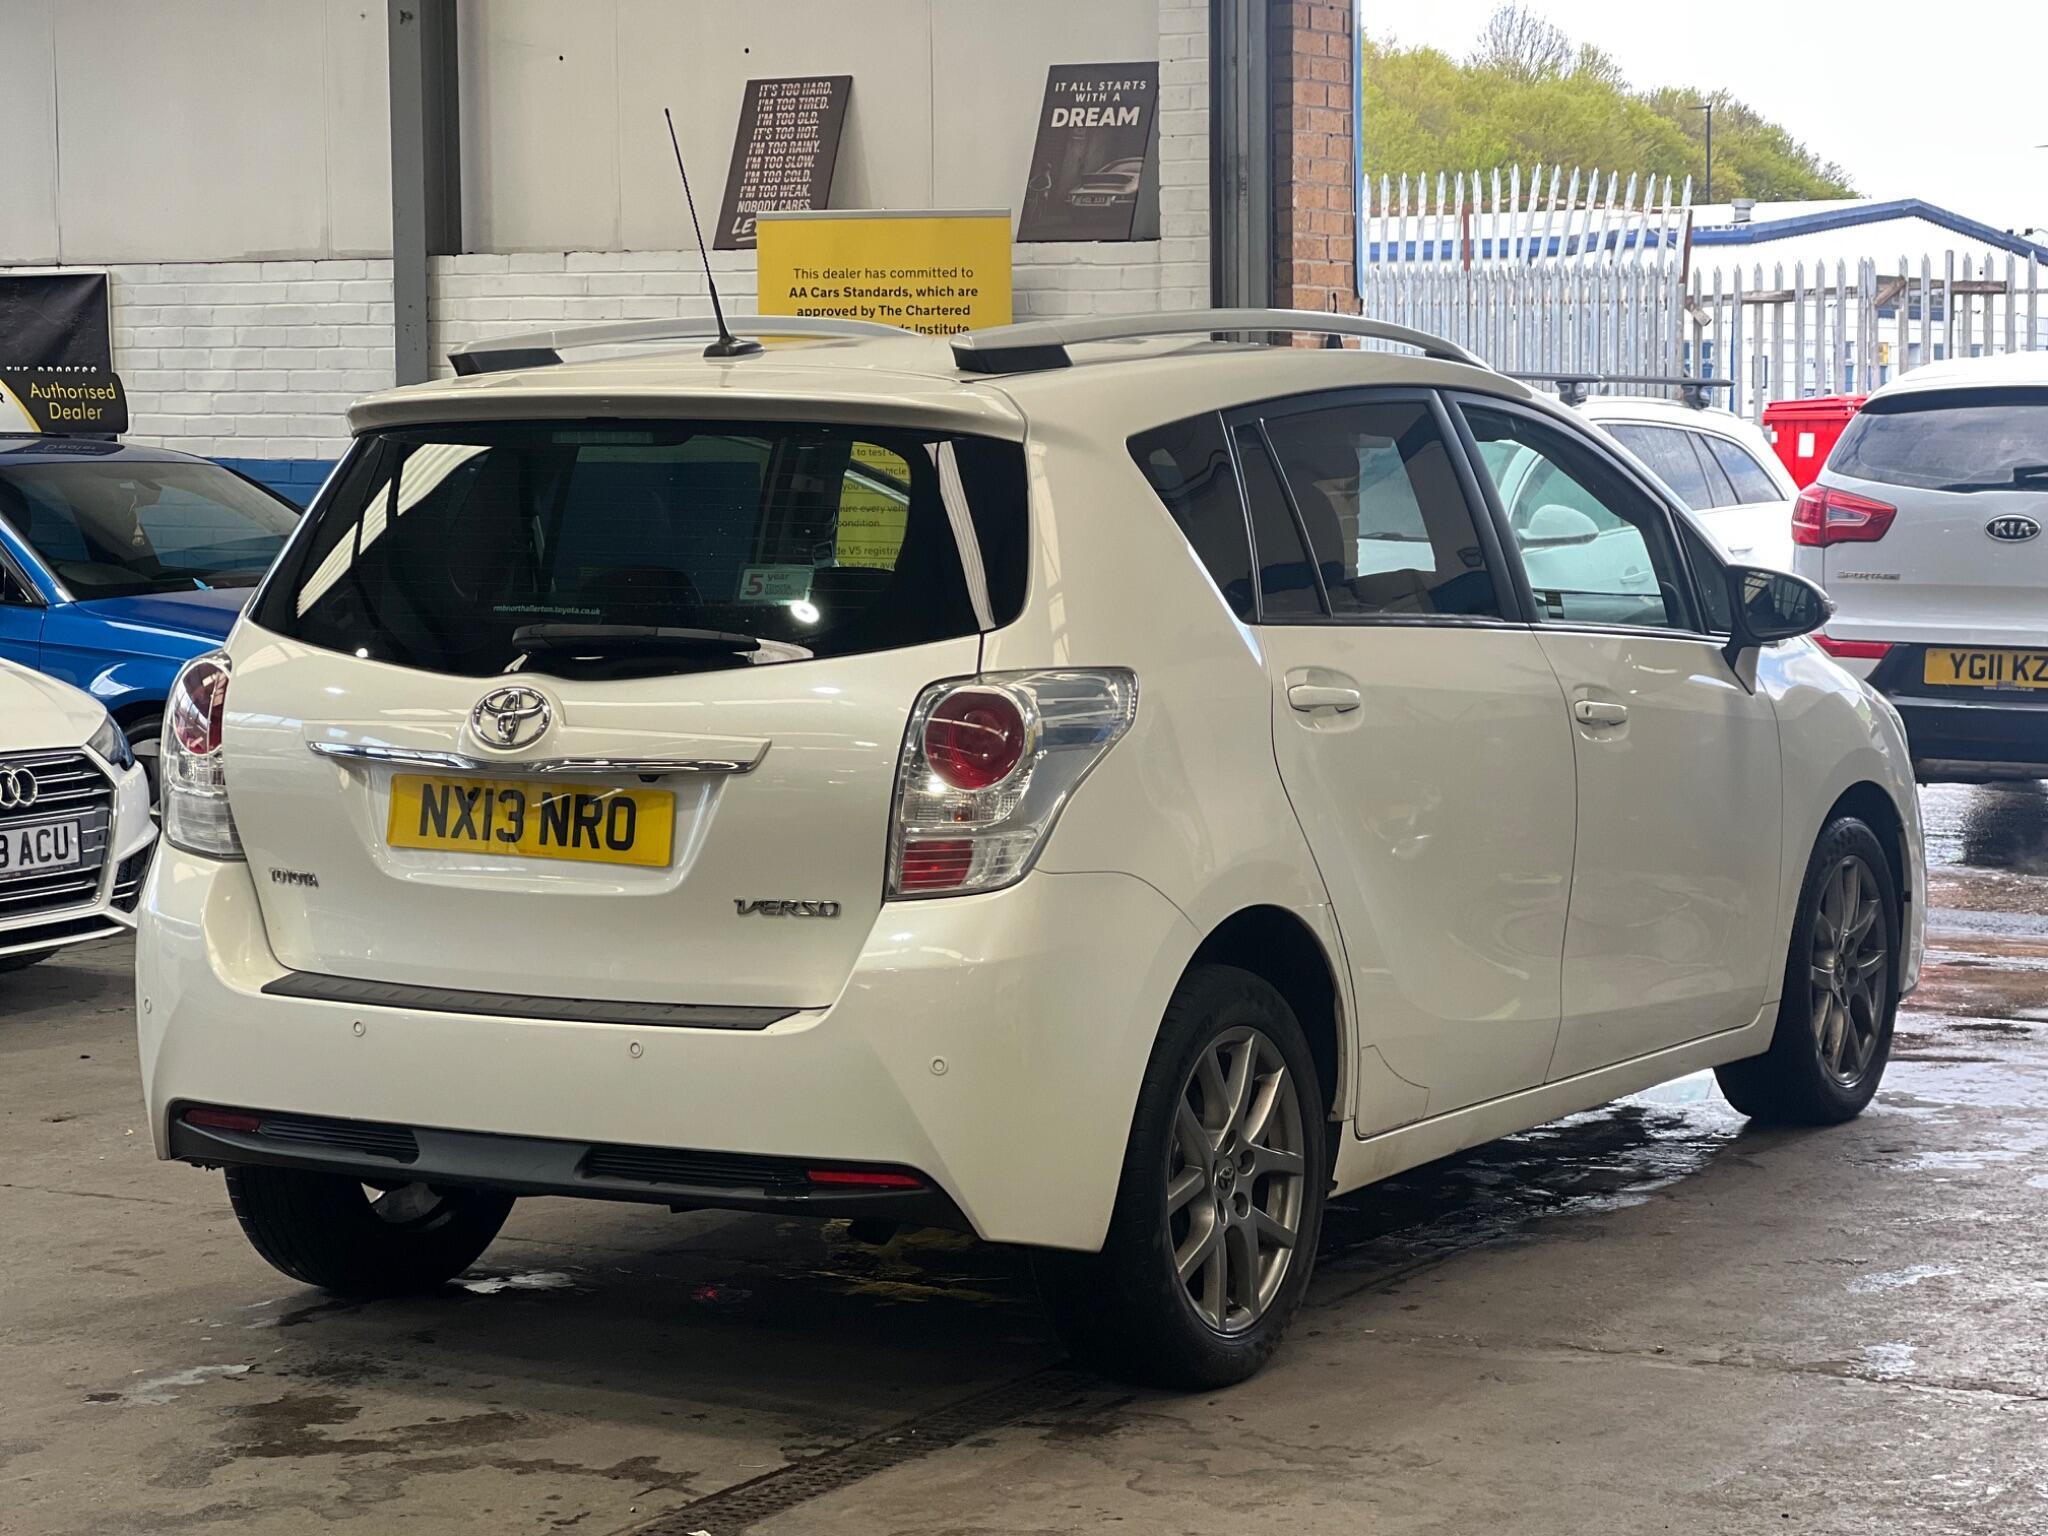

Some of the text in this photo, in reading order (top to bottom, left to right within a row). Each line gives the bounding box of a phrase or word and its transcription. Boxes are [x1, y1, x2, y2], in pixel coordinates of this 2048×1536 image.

[758, 81, 832, 97] IT'S TOO HARD.
[1055, 80, 1147, 92] IT ALL STARTS
[757, 96, 829, 112] I'M TOO TIRED.
[1075, 92, 1121, 102] WITH A
[756, 111, 819, 126] I'M TOO OLD.
[1050, 105, 1140, 128] DREAM
[753, 125, 818, 140] IT'S TOO HOT.
[748, 139, 820, 155] I'M TOO RAINY.
[745, 154, 815, 170] I'M TOO SLOW.
[743, 169, 812, 184] I'M TOO COLD.
[739, 183, 811, 198] I'M TOO WEAK.
[736, 199, 776, 213] NOBODY
[793, 266, 974, 279] This dealer has committed to
[788, 285, 979, 299] AA Cars Standards, which are
[796, 304, 971, 318] approved by The Chartered
[914, 323, 970, 335] Institute
[30, 381, 117, 400] Authorised
[48, 401, 103, 420] Dealer
[868, 448, 887, 457] test
[1993, 521, 2032, 537] KIA
[746, 573, 763, 596] 5
[1950, 652, 2048, 682] YG11 KZ
[418, 783, 637, 851] NX13 NRO
[19, 825, 70, 866] ACU
[733, 898, 841, 917] VERSO
